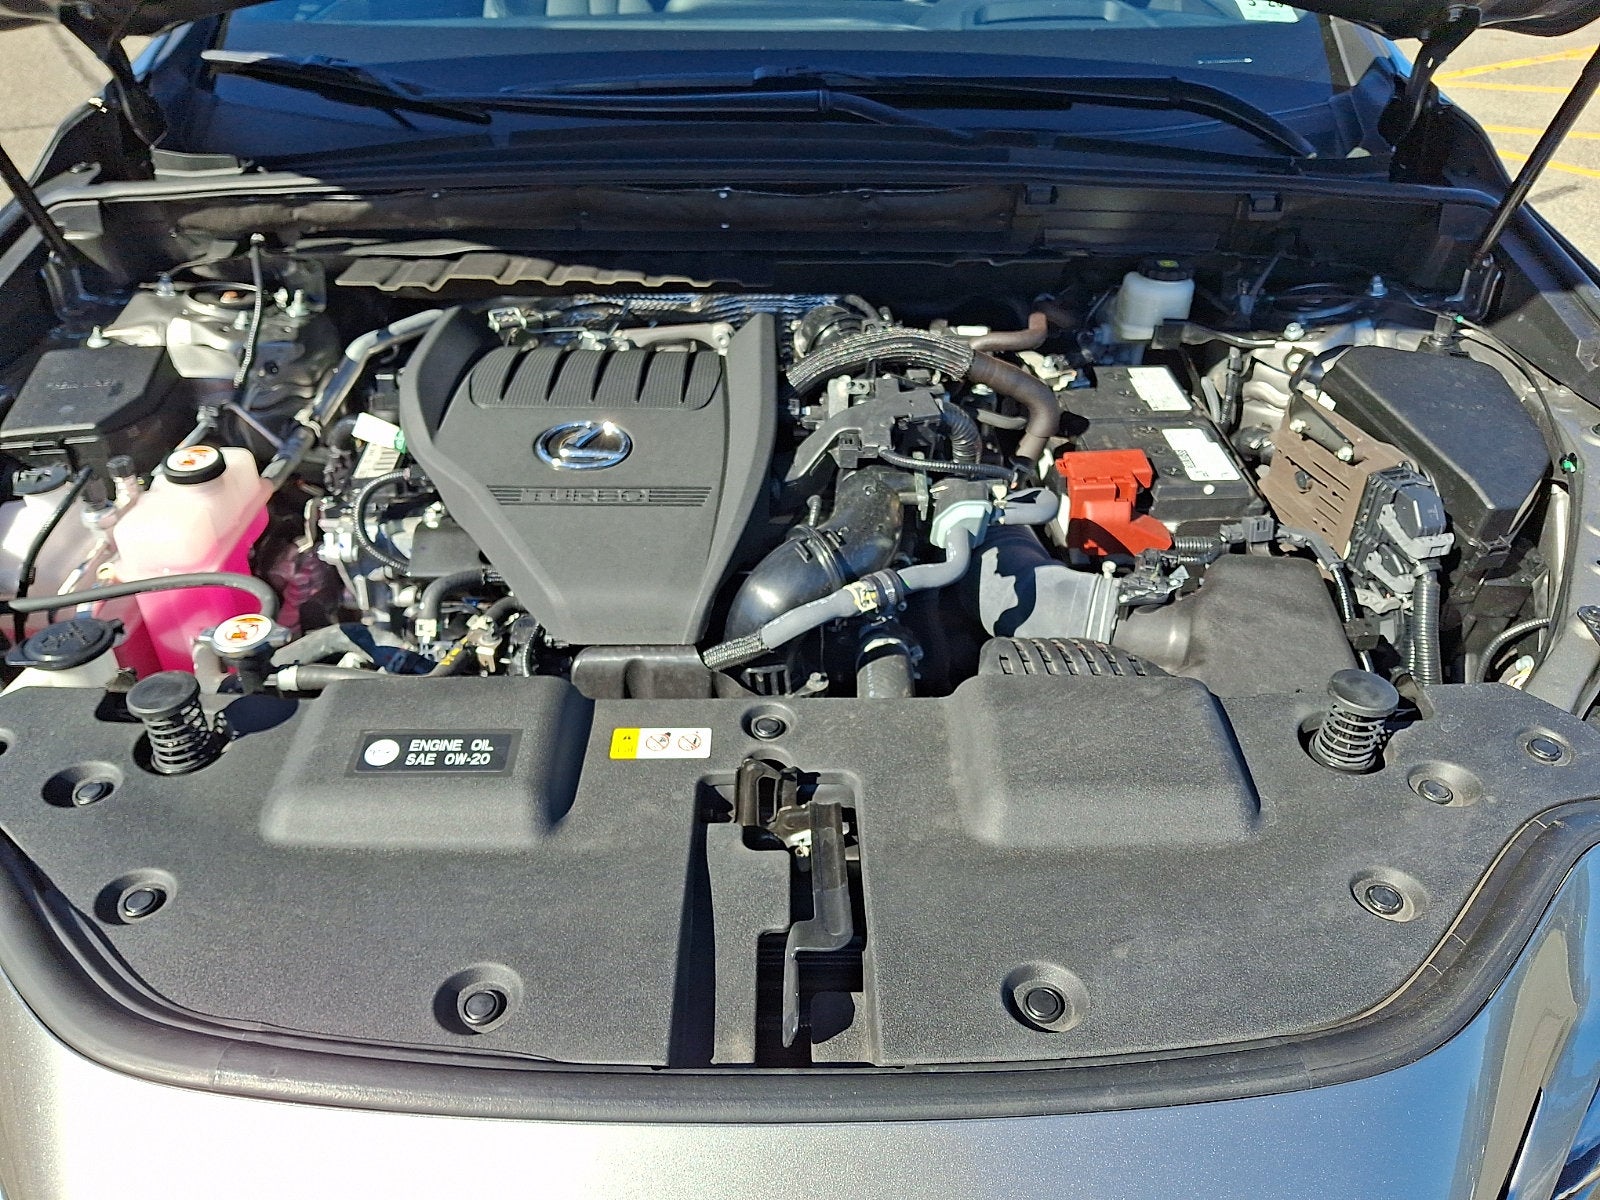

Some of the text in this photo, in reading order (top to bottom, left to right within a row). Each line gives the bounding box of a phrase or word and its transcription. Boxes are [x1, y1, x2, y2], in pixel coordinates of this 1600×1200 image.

[525, 489, 646, 502] TURBO
[408, 738, 464, 752] ENGINE
[470, 738, 494, 752] OIL
[405, 753, 491, 766] SAE 0W-20
